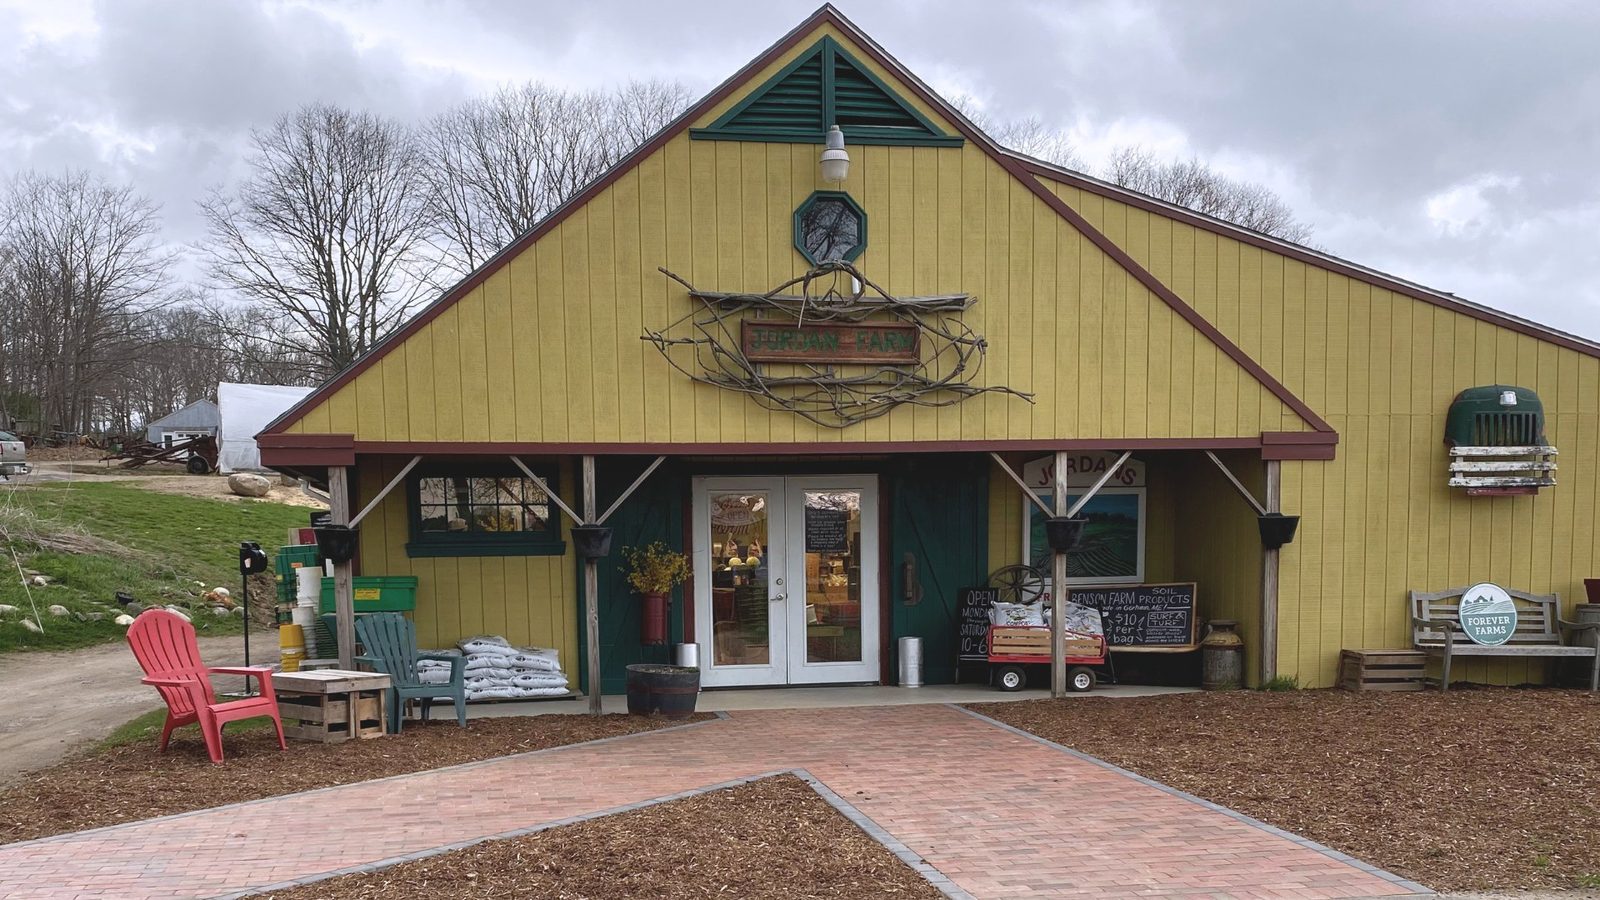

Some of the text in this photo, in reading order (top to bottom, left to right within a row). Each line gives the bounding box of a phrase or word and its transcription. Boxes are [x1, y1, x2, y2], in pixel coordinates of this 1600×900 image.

[751, 328, 913, 352] JORDAN FARM
[1152, 587, 1177, 595] SOIL
[967, 590, 995, 606] OPEN
[1071, 591, 1135, 605] BENSON FARM
[1139, 595, 1190, 604] PRODUCTS
[962, 608, 989, 618] MONDA
[1115, 613, 1137, 625] $10
[1468, 616, 1510, 626] FOREVER
[960, 624, 989, 636] SATURDA
[1475, 626, 1507, 635] FARMS
[961, 637, 988, 654] 10-6
[1113, 634, 1134, 646] bag
